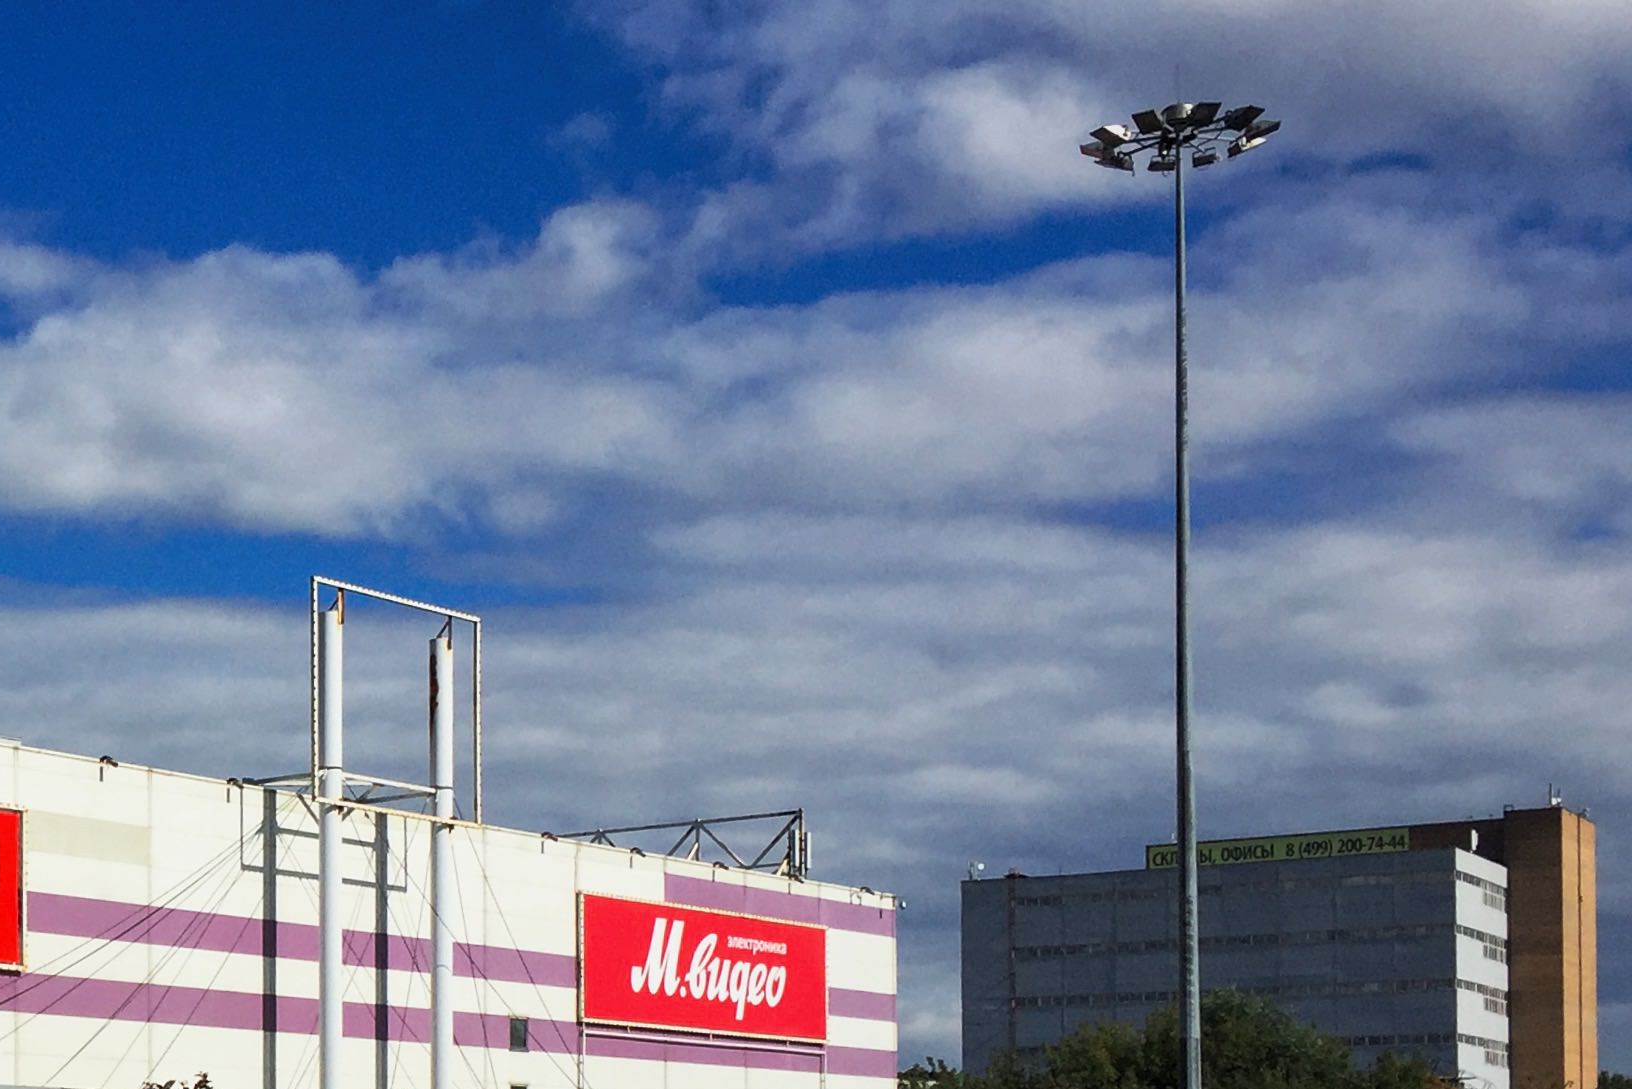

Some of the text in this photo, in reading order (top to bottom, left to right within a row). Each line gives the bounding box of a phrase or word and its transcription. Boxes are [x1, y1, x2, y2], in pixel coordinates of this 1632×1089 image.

[1152, 834, 1406, 867] СКЛЫ, ОФИСЫ 8 (499) 200-74-44
